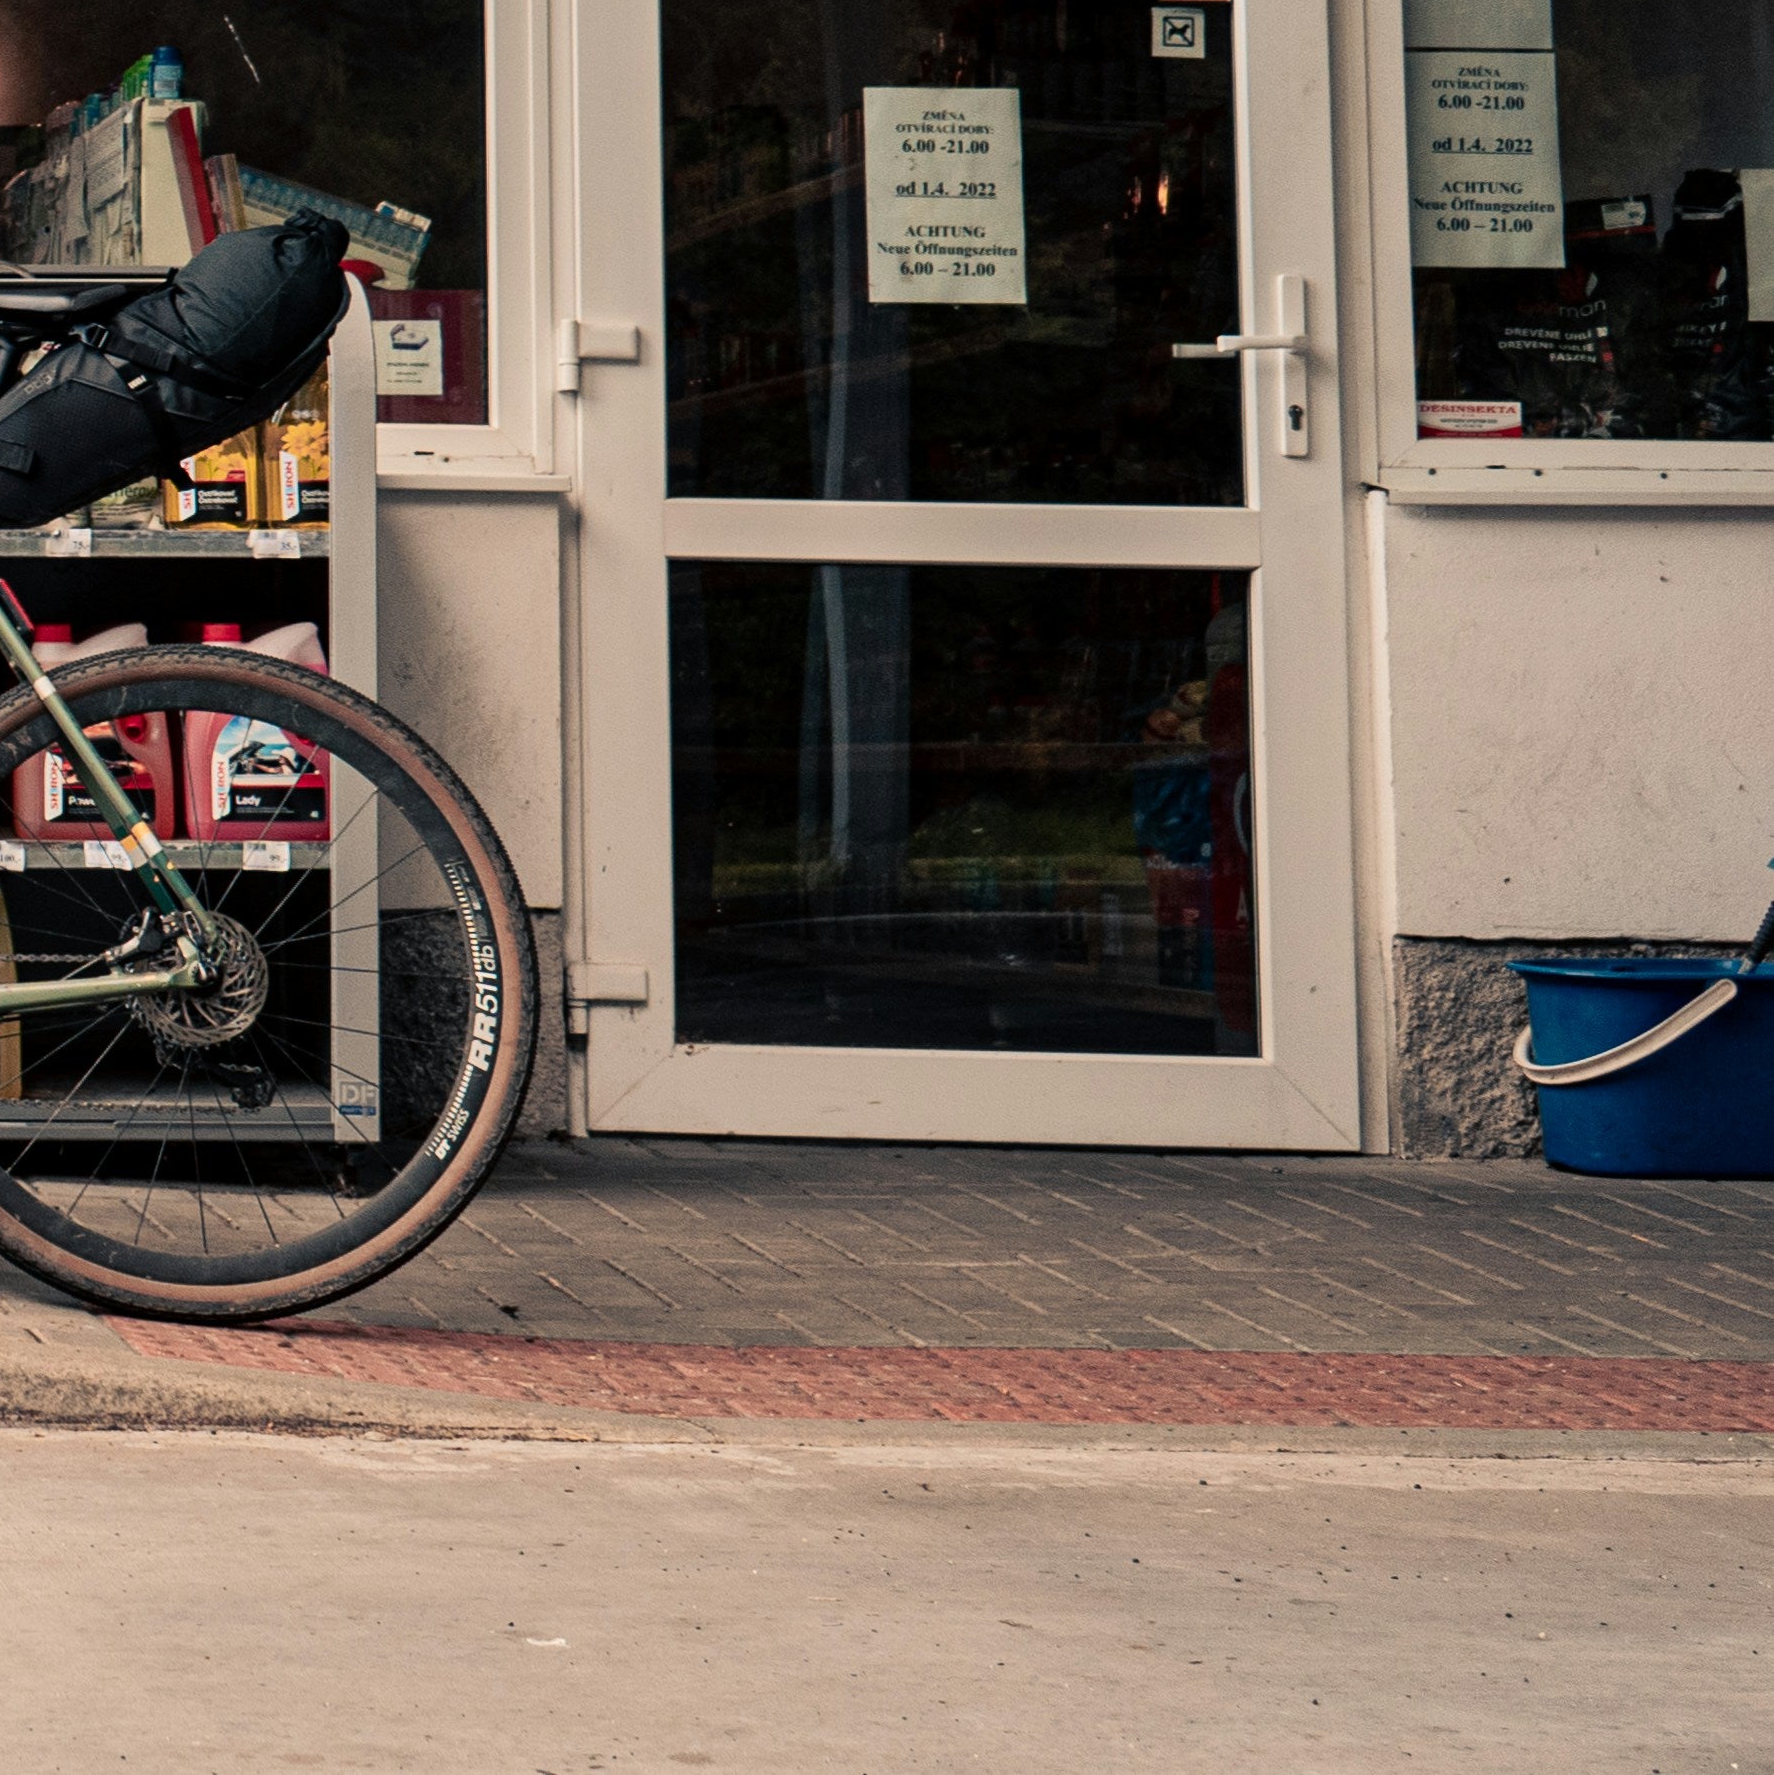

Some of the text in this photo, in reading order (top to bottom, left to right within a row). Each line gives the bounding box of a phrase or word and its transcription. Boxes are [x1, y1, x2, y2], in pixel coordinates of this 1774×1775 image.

[1437, 94, 1525, 110] 6.00 -21.00
[922, 110, 965, 121] ZMĚNA
[895, 123, 956, 134] OTVÍRACÍ
[901, 139, 989, 154] 6.00 -21.00
[1432, 137, 1533, 153] od 1.4. 2022
[896, 181, 996, 197] od 1.4. 2022
[1440, 181, 1523, 194] ACHTUNG
[1414, 197, 1555, 213] Neue Öffnungszeiten
[905, 225, 986, 238] ACHTUNG
[1436, 217, 1470, 232] 6.00
[1490, 218, 1533, 232] 21.00
[877, 240, 1018, 258] Neue Öffnungszeiten
[899, 261, 934, 276] 6.00
[952, 262, 995, 276] 21.00
[1419, 404, 1517, 414] DESINSEKTA
[235, 794, 262, 807] Lady
[468, 944, 499, 1072] RR511db
[435, 1108, 470, 1160] DT SWISS
